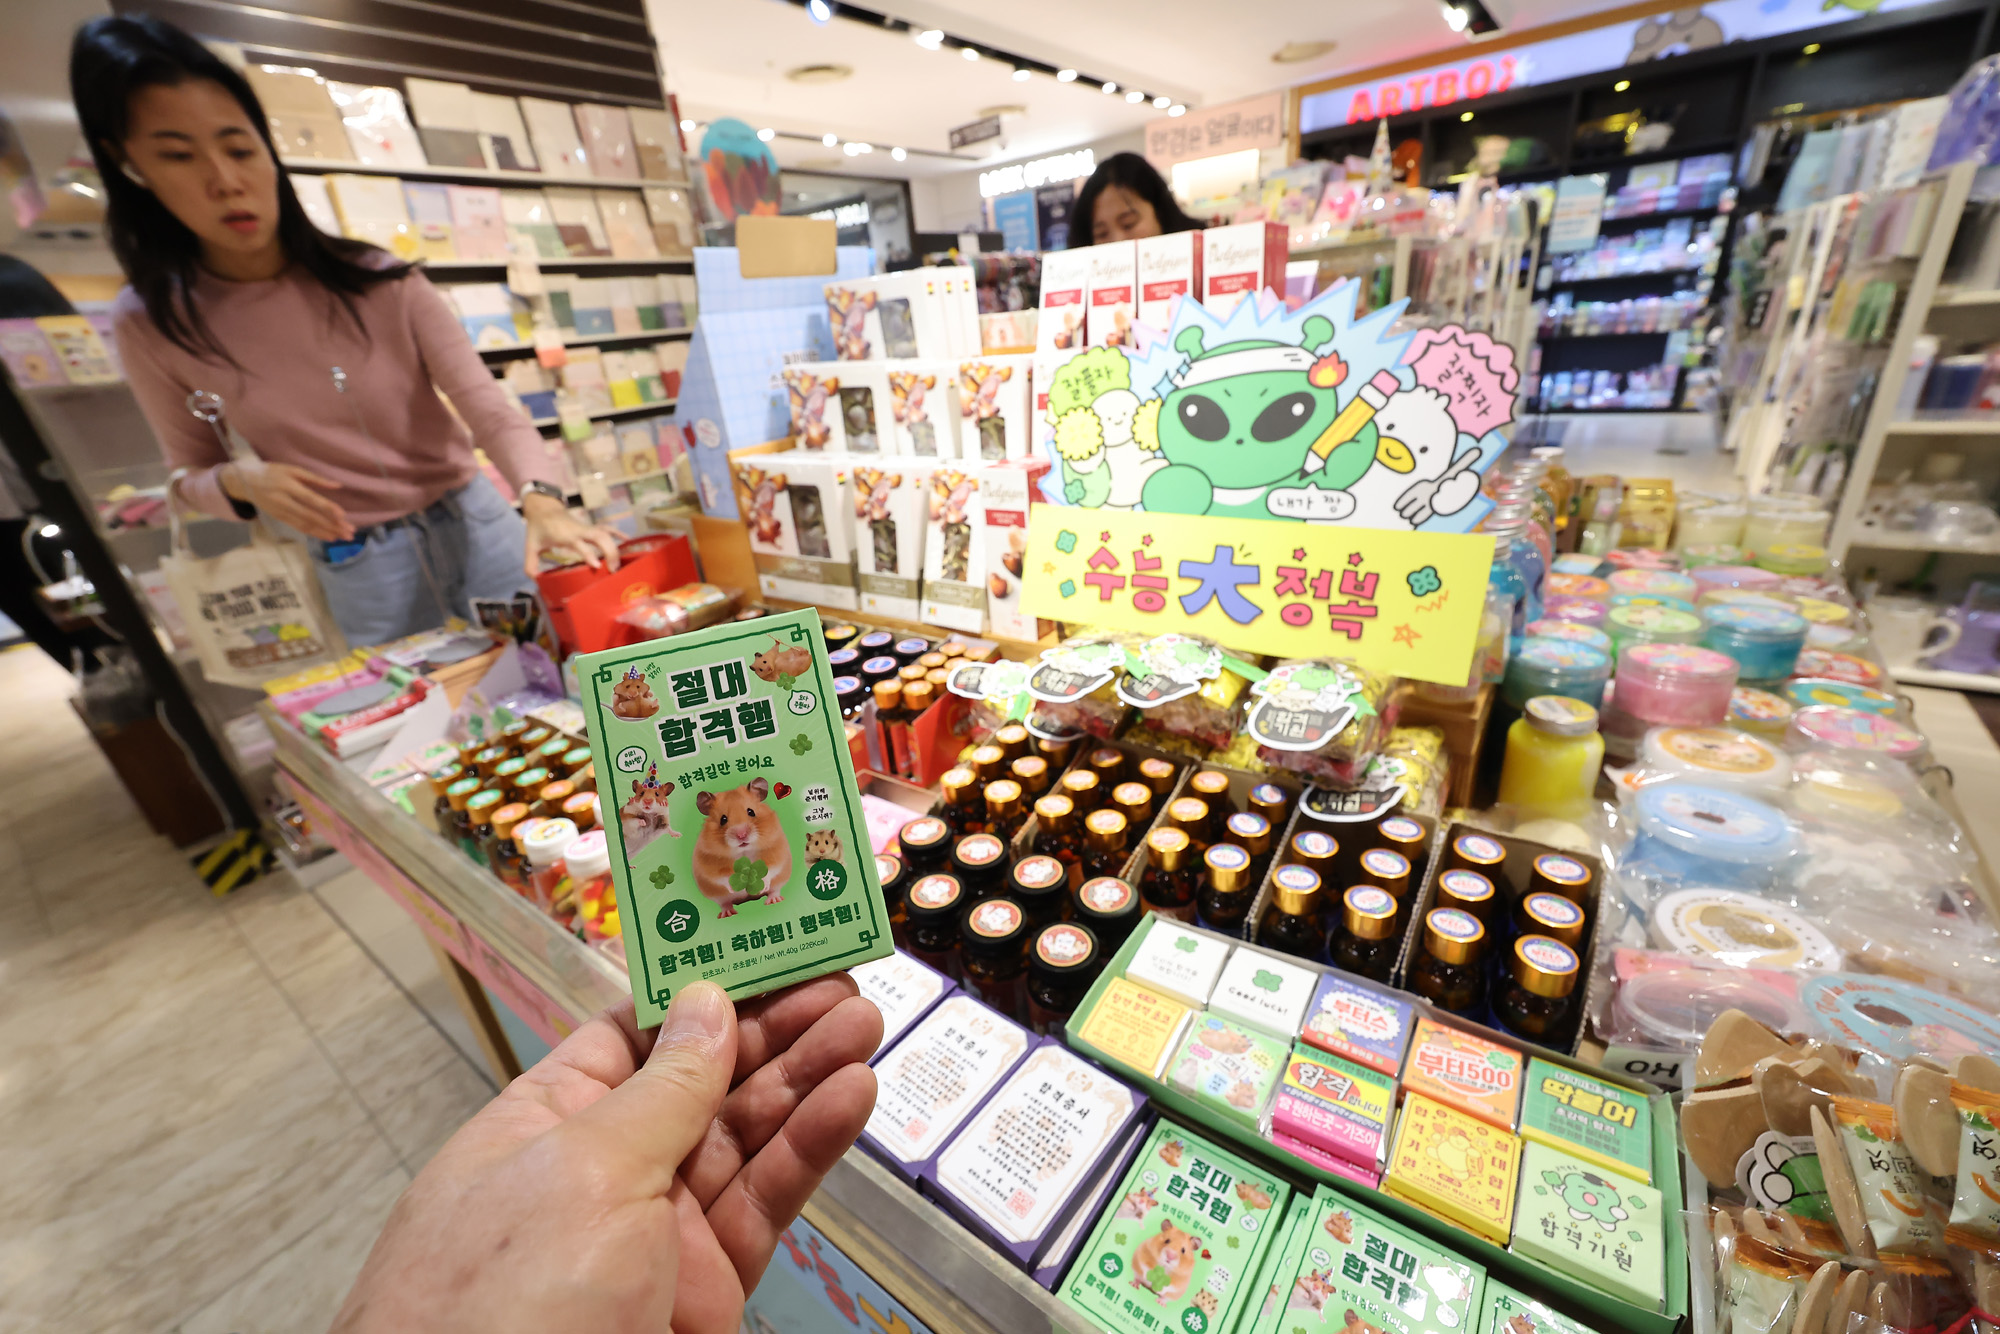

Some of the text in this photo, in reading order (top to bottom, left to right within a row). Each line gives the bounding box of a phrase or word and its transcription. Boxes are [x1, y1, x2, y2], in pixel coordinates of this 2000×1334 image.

[1437, 352, 1494, 421] 잘찍자
[1278, 494, 1342, 515] 내가 짱
[1084, 546, 1169, 613] 수능
[1274, 566, 1380, 640] 정복
[671, 660, 748, 710] 절대
[658, 699, 776, 759] 합격햄
[678, 754, 775, 790] 합격길만 걸어요
[815, 868, 840, 892] 格
[658, 902, 862, 976] 합격햄! 축하햄! 행복햄!
[664, 910, 691, 934] 合
[764, 952, 775, 962] Net
[1228, 986, 1289, 1016] Good luck!
[1333, 999, 1389, 1031] 부터스
[1298, 1062, 1354, 1101] 합격
[1417, 1050, 1511, 1087] 부터500
[1039, 1082, 1090, 1119] 합격증서
[1188, 1157, 1233, 1194] 절대
[1165, 1173, 1233, 1225] 합격햄
[1363, 1232, 1419, 1280] 절대
[1539, 1216, 1633, 1273] 합격기원
[1085, 1272, 1120, 1303] 합격햄!
